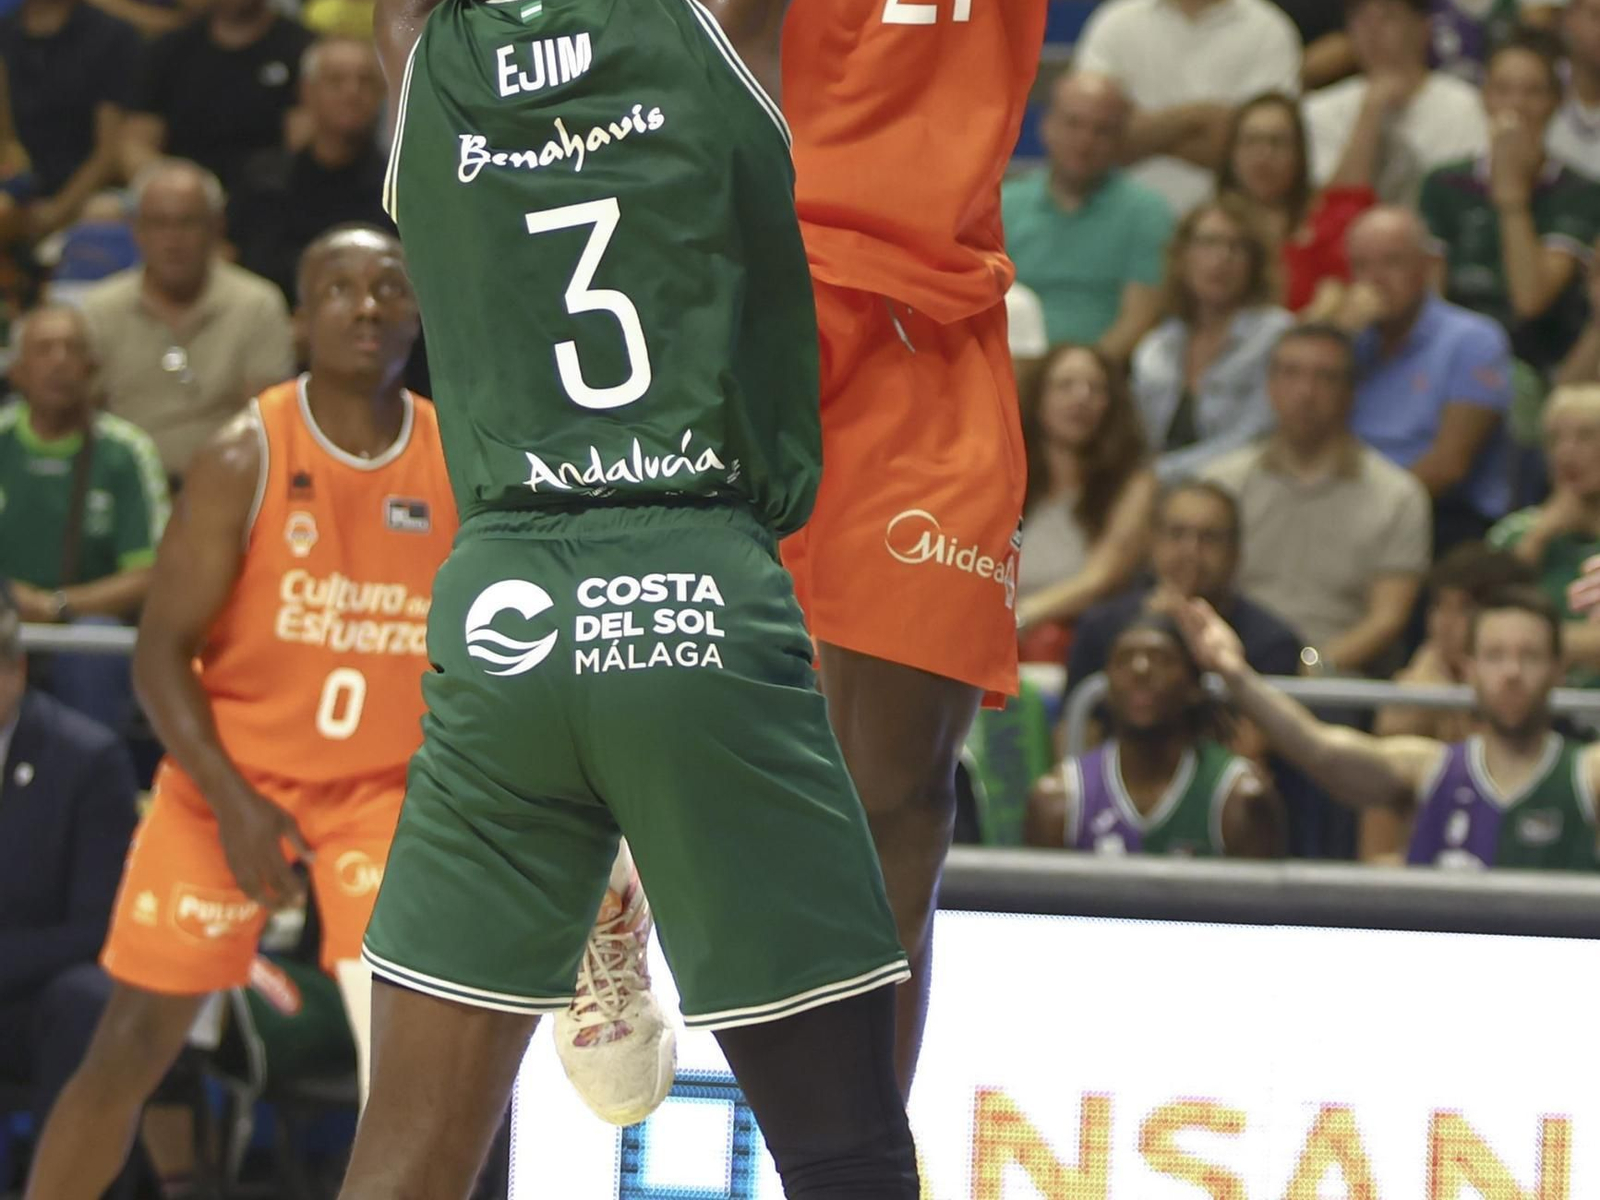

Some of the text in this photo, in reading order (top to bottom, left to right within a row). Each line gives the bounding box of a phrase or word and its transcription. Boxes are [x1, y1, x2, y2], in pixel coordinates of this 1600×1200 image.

[496, 32, 593, 97] EJIM
[525, 197, 652, 409] 3
[523, 428, 725, 492] Andalucía
[900, 527, 1006, 584] Midea
[280, 568, 407, 616] Cultura
[577, 573, 725, 607] COSTA
[575, 609, 725, 640] DEL SOL
[575, 636, 725, 675] MÁLAGA
[316, 668, 367, 740] 0
[917, 1084, 1573, 1200] NSAN
